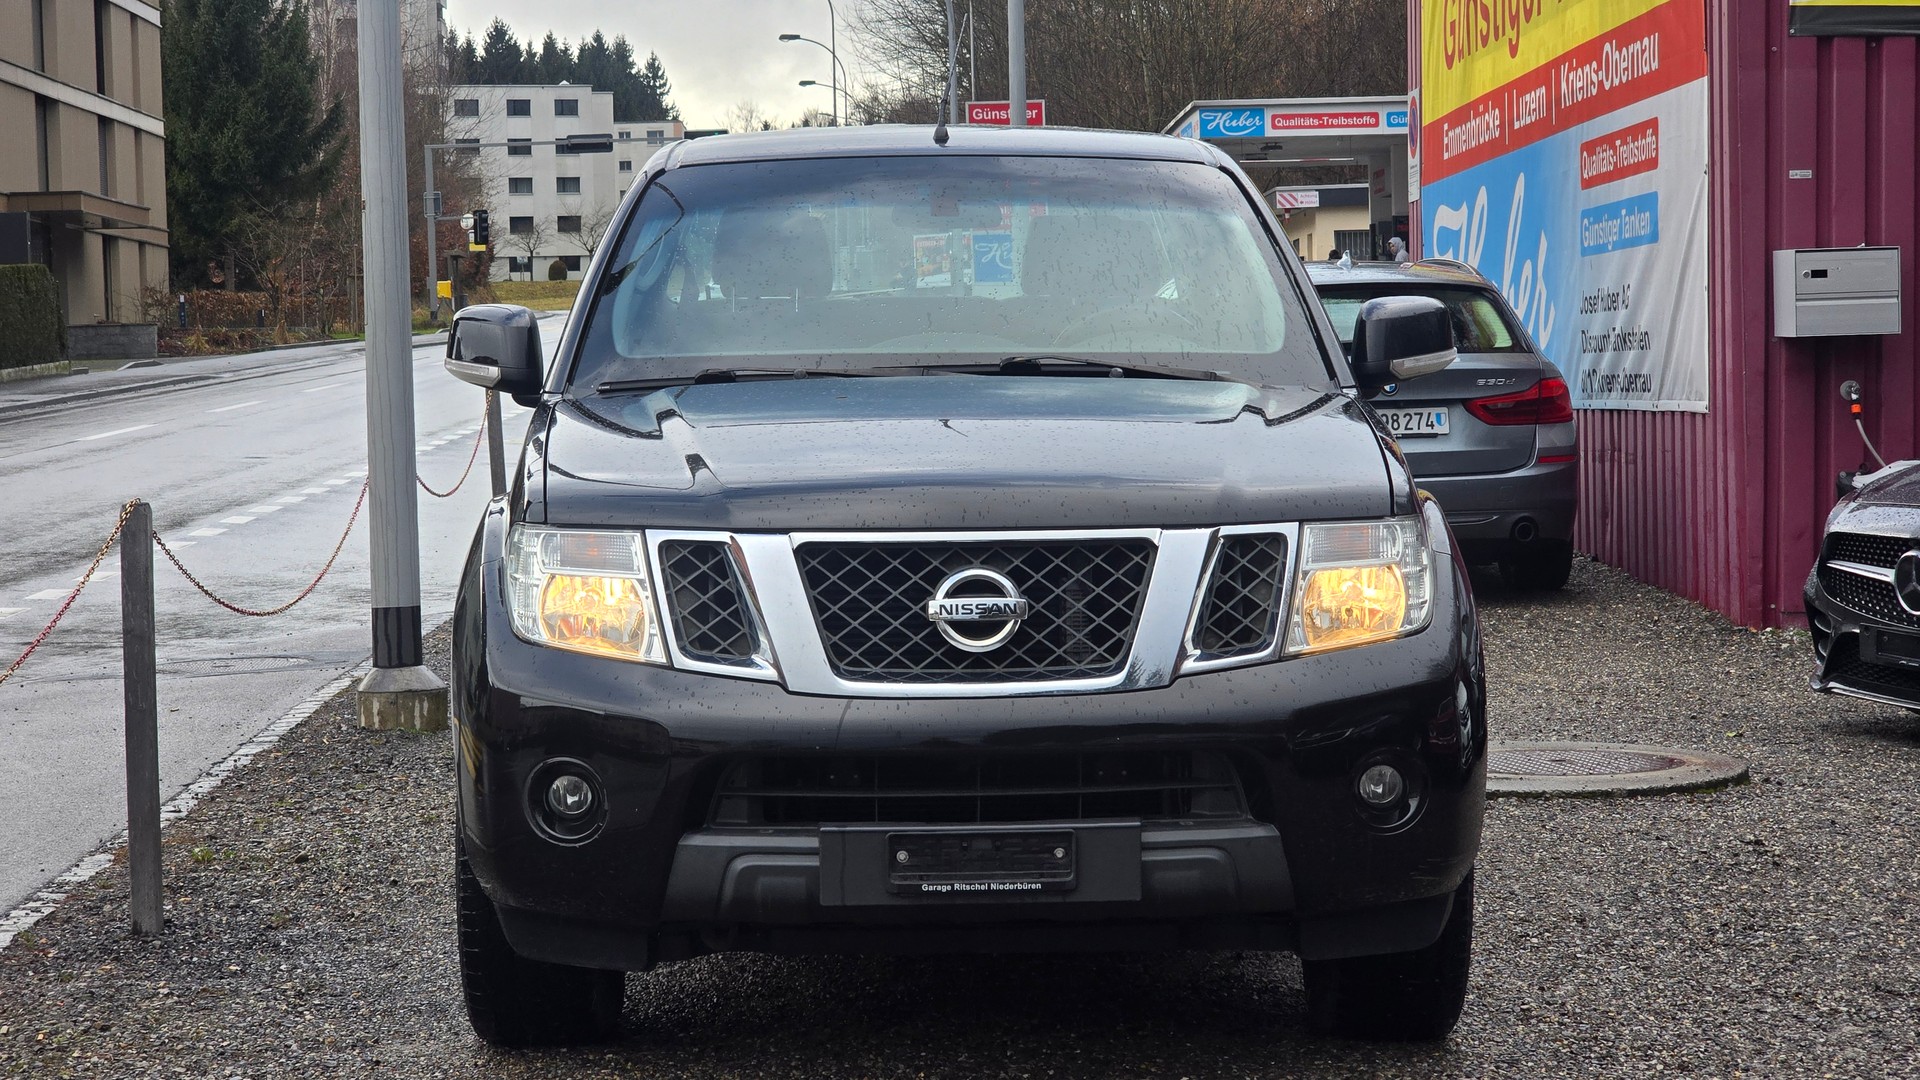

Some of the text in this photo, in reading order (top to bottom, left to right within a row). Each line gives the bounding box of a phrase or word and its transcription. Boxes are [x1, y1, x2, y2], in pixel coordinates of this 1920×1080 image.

[1443, 0, 1541, 70] Günstig
[1443, 33, 1659, 160] Emmenbrücke Luzern Kriens-Obernau
[972, 108, 1038, 120] Günser
[1201, 111, 1263, 136] Huber
[1274, 116, 1376, 126] Qualitäts-Treibstoffe
[1582, 128, 1656, 180] Qualitäts-Treibstoffe
[1582, 206, 1650, 250] Günstiger Tanken
[1580, 288, 1600, 315] Josef
[939, 603, 1017, 616] NISSAN
[921, 882, 1042, 892] Garage Ritschel Niederbüren
